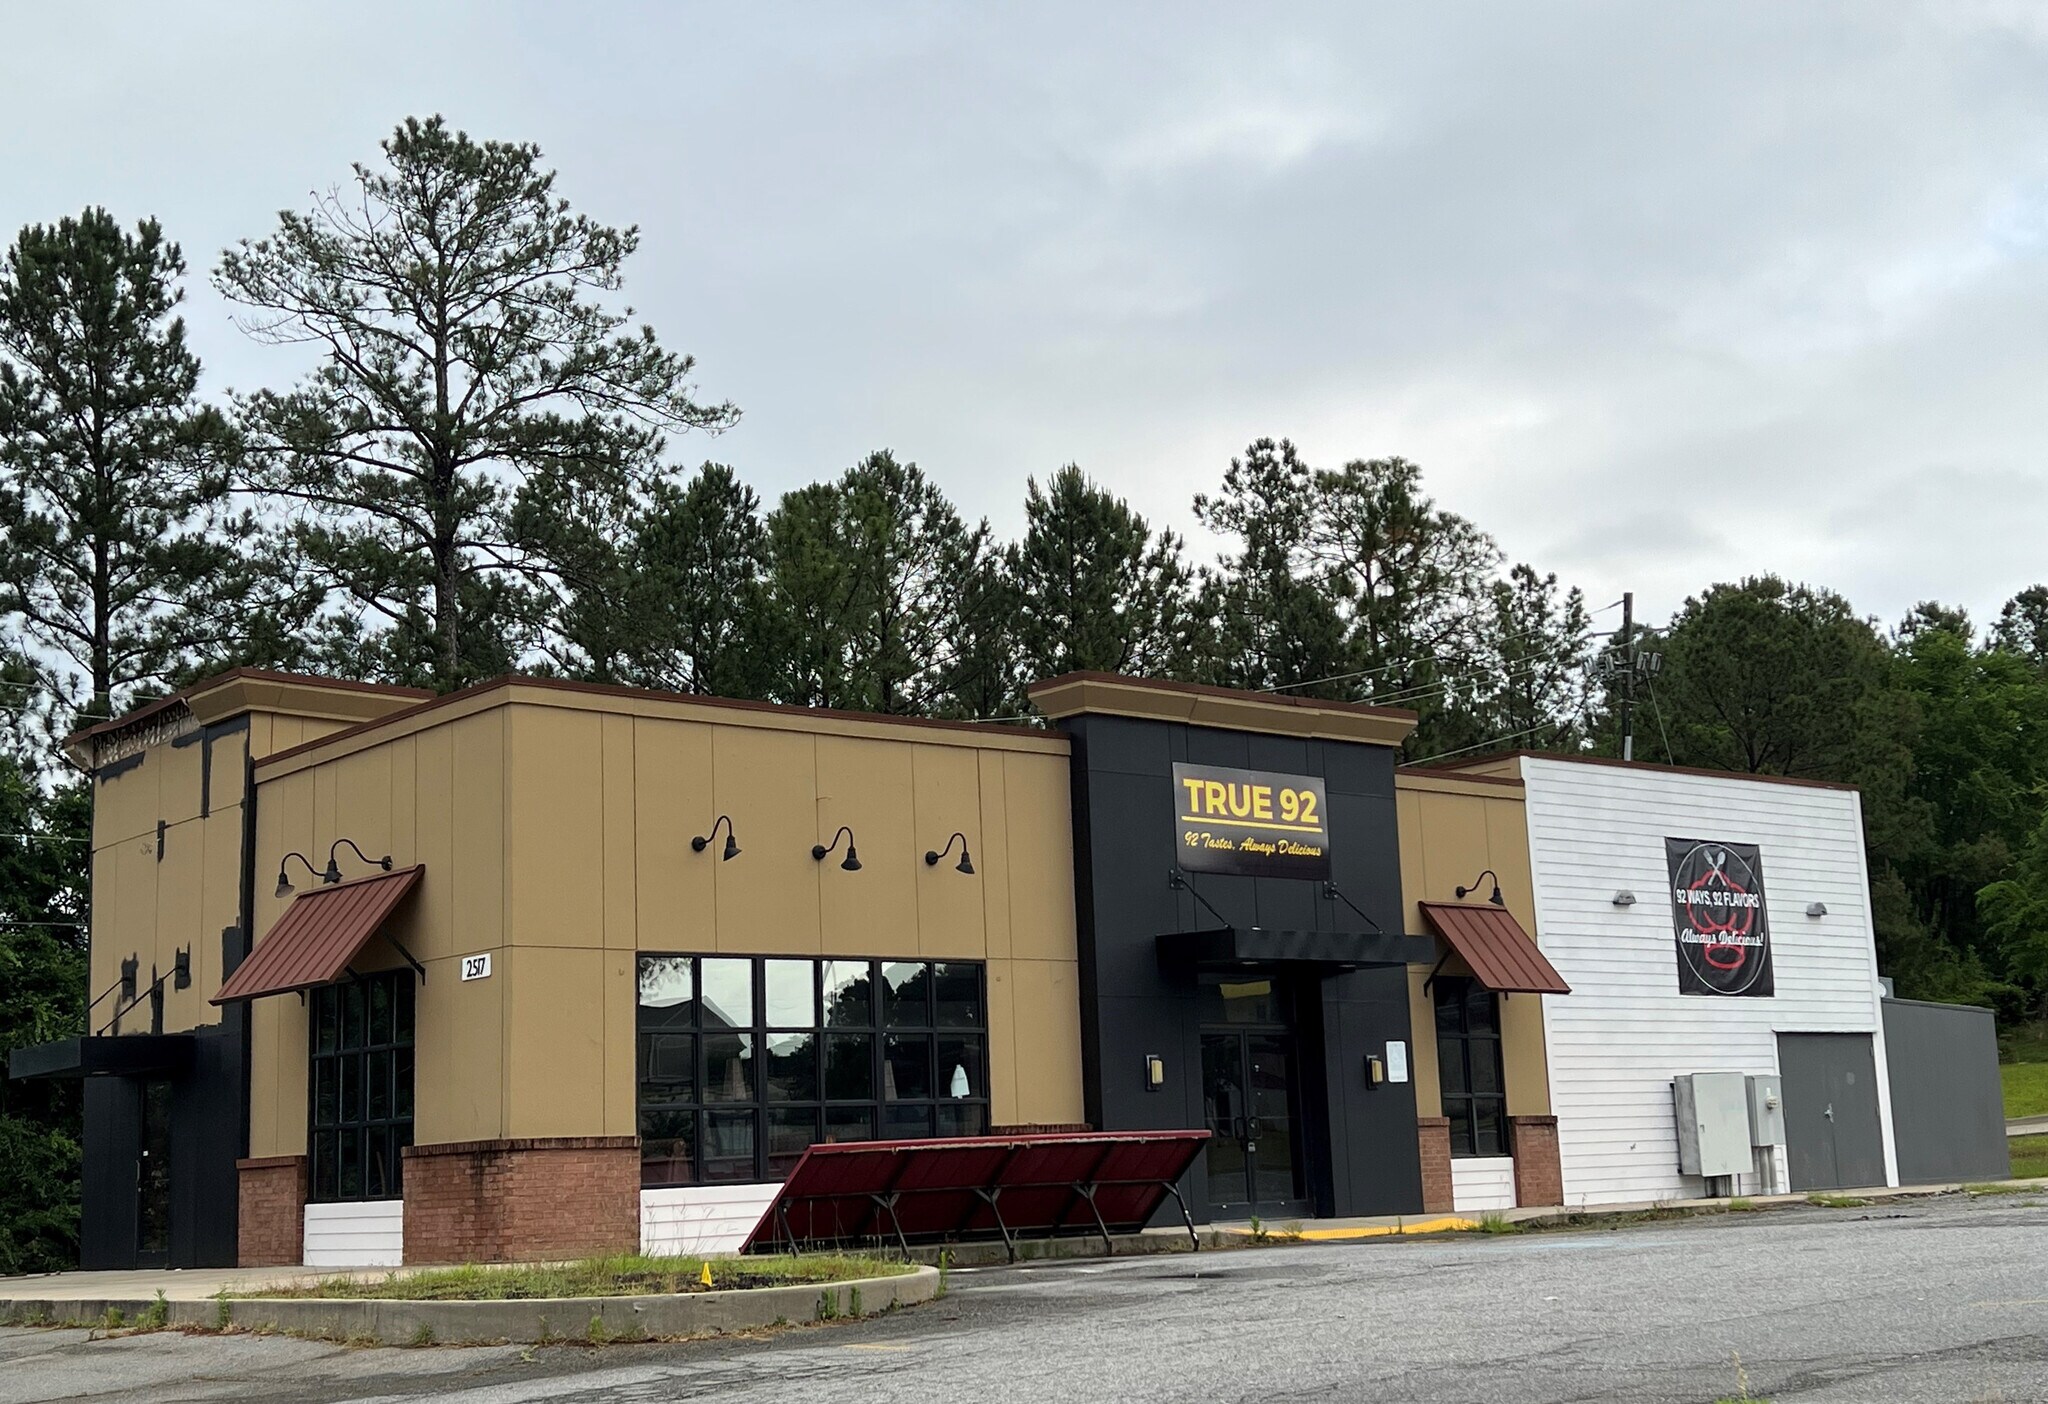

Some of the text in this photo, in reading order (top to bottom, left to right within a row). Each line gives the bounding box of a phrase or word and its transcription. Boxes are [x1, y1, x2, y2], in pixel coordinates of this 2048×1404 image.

[1183, 778, 1319, 824] TRUE 92
[1184, 831, 1199, 847] 92
[1239, 837, 1277, 857] Always
[1278, 840, 1322, 856] Delicious
[1676, 889, 1760, 908] 92 WAYS, 92 FLAVORS
[1681, 927, 1764, 948] Always Delicious!
